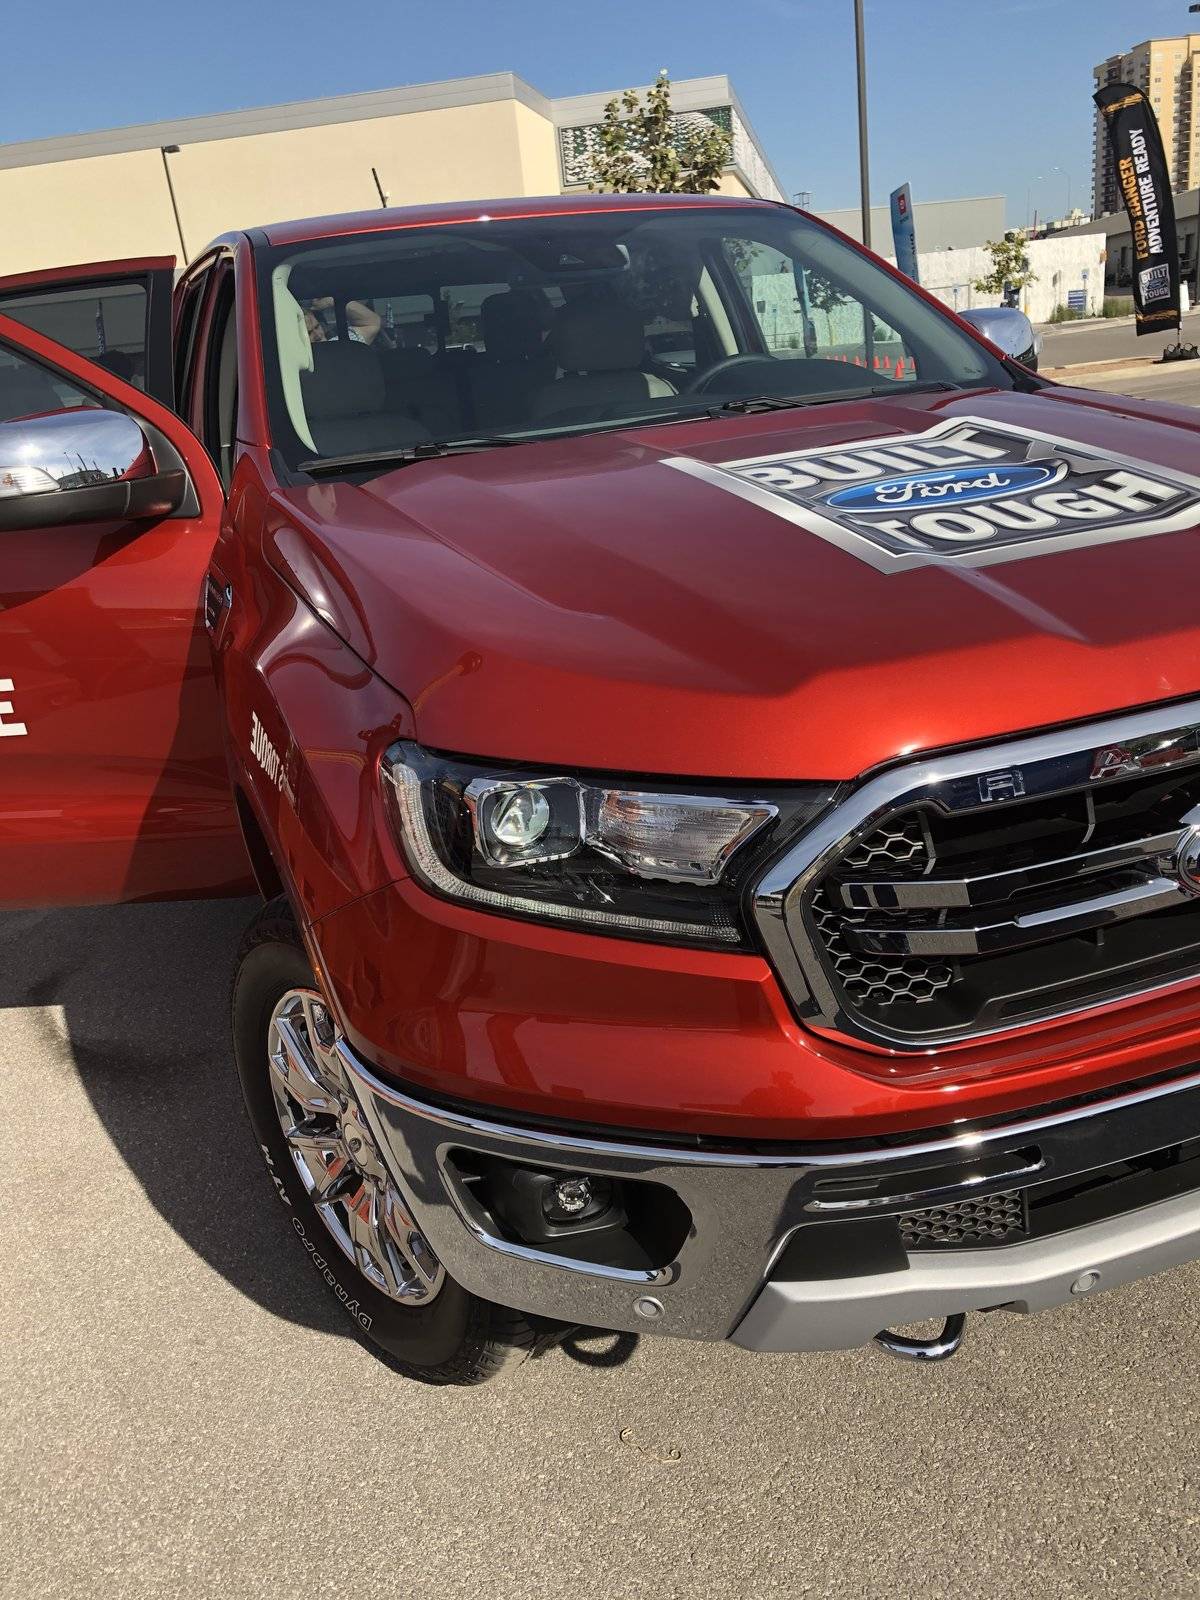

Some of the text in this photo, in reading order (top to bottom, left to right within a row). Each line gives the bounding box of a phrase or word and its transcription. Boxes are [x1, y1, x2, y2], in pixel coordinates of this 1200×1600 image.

[1129, 129, 1149, 173] READY
[1119, 157, 1148, 260] FORD RANGER
[1137, 173, 1163, 254] ADVENTURE
[1141, 268, 1167, 283] BUILT
[739, 427, 1012, 491] BUILT
[874, 472, 1012, 503] Ford
[840, 472, 1184, 548] TOUGH
